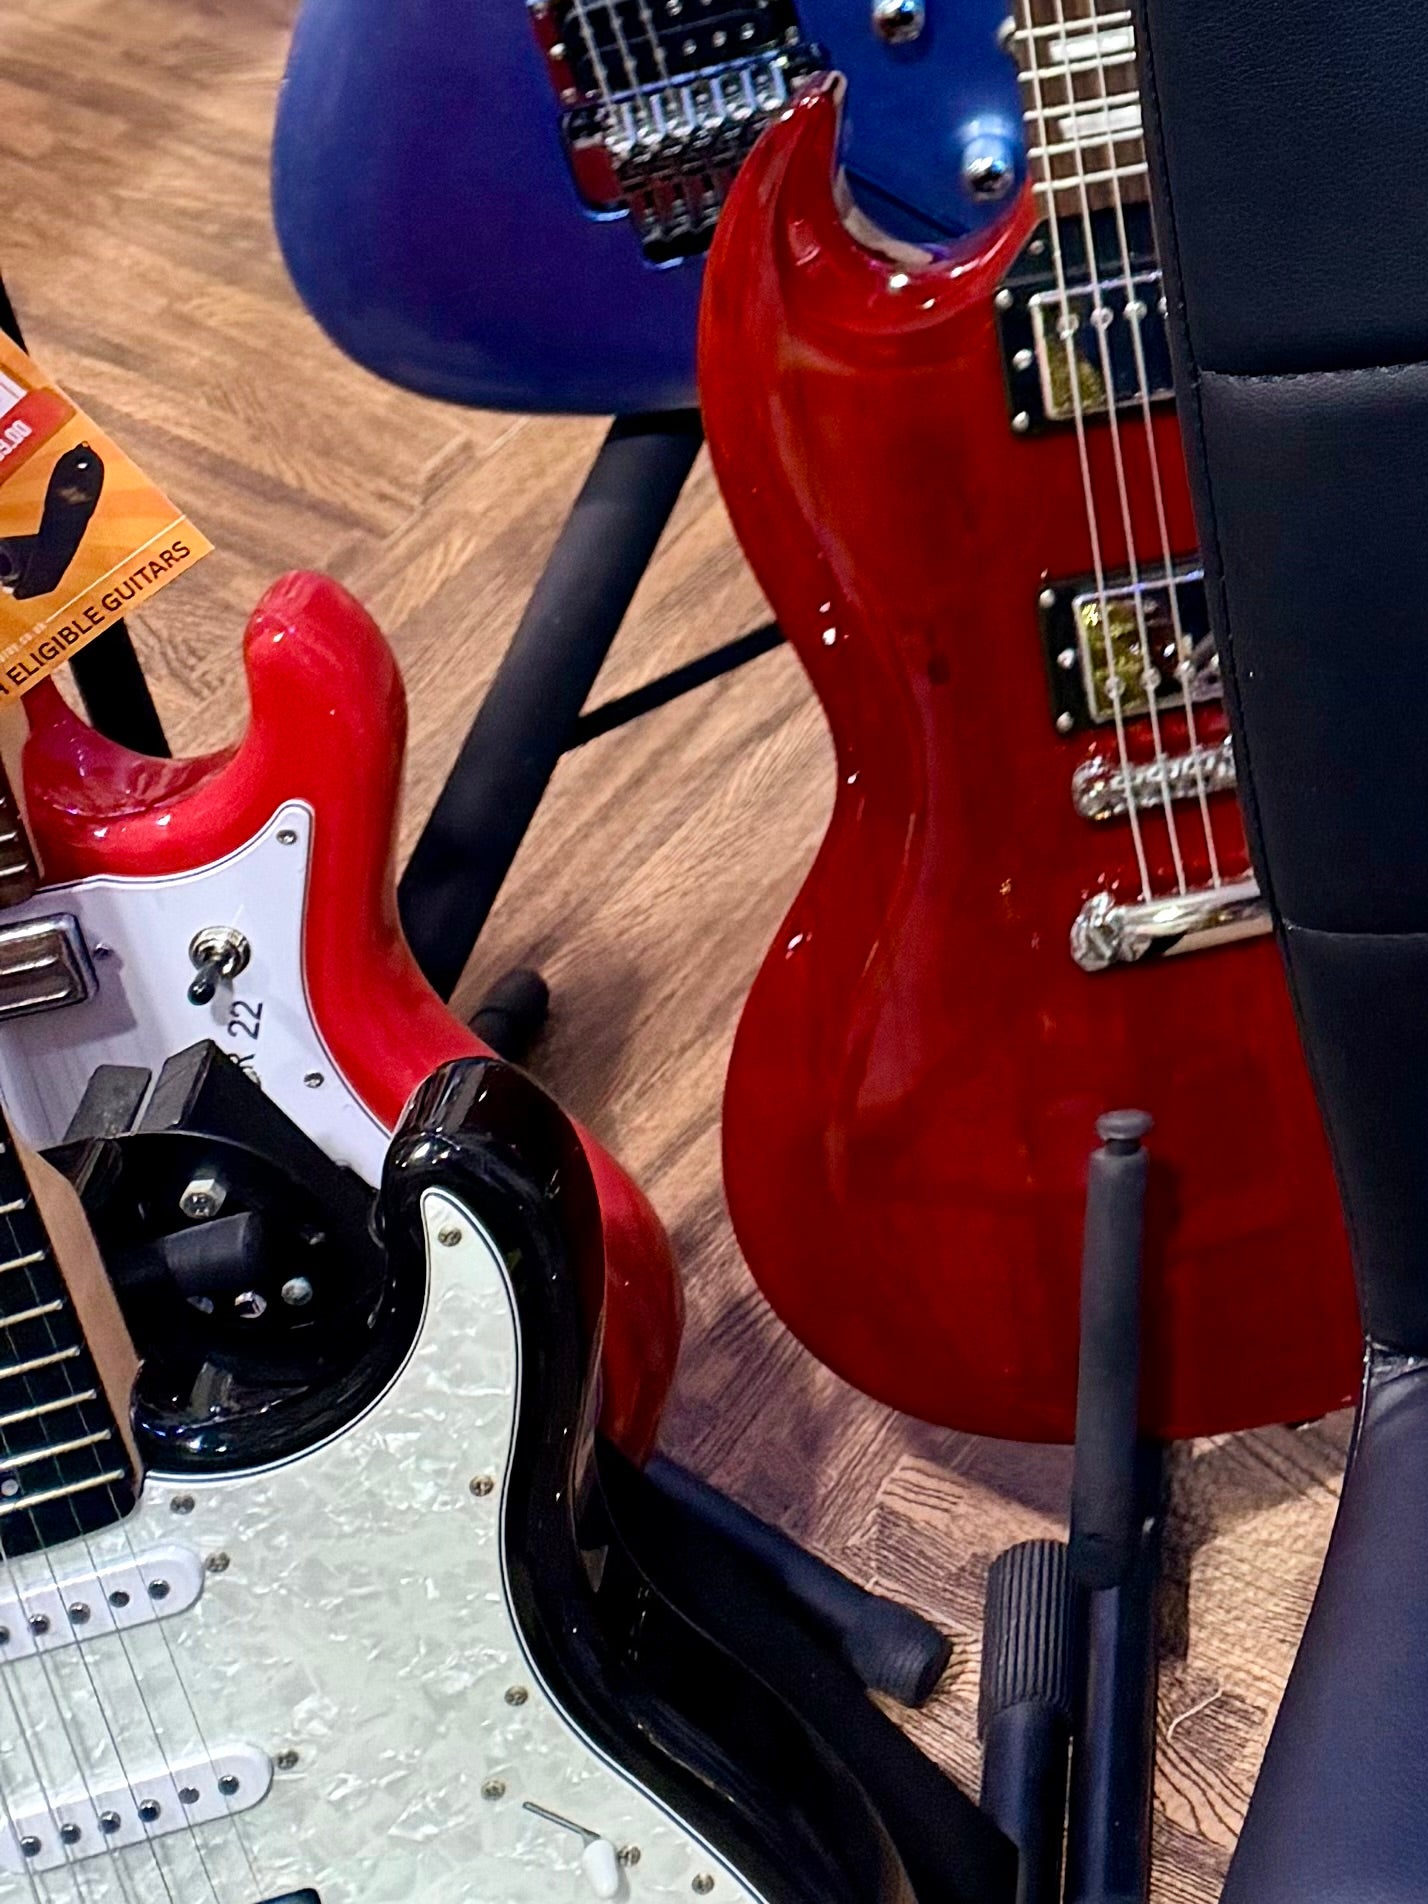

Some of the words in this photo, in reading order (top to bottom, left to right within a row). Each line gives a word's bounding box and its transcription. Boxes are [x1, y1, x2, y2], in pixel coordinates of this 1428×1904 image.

[5, 605, 105, 687] ELIGIBLE
[101, 540, 192, 612] GUITARS
[227, 1000, 263, 1040] 22
